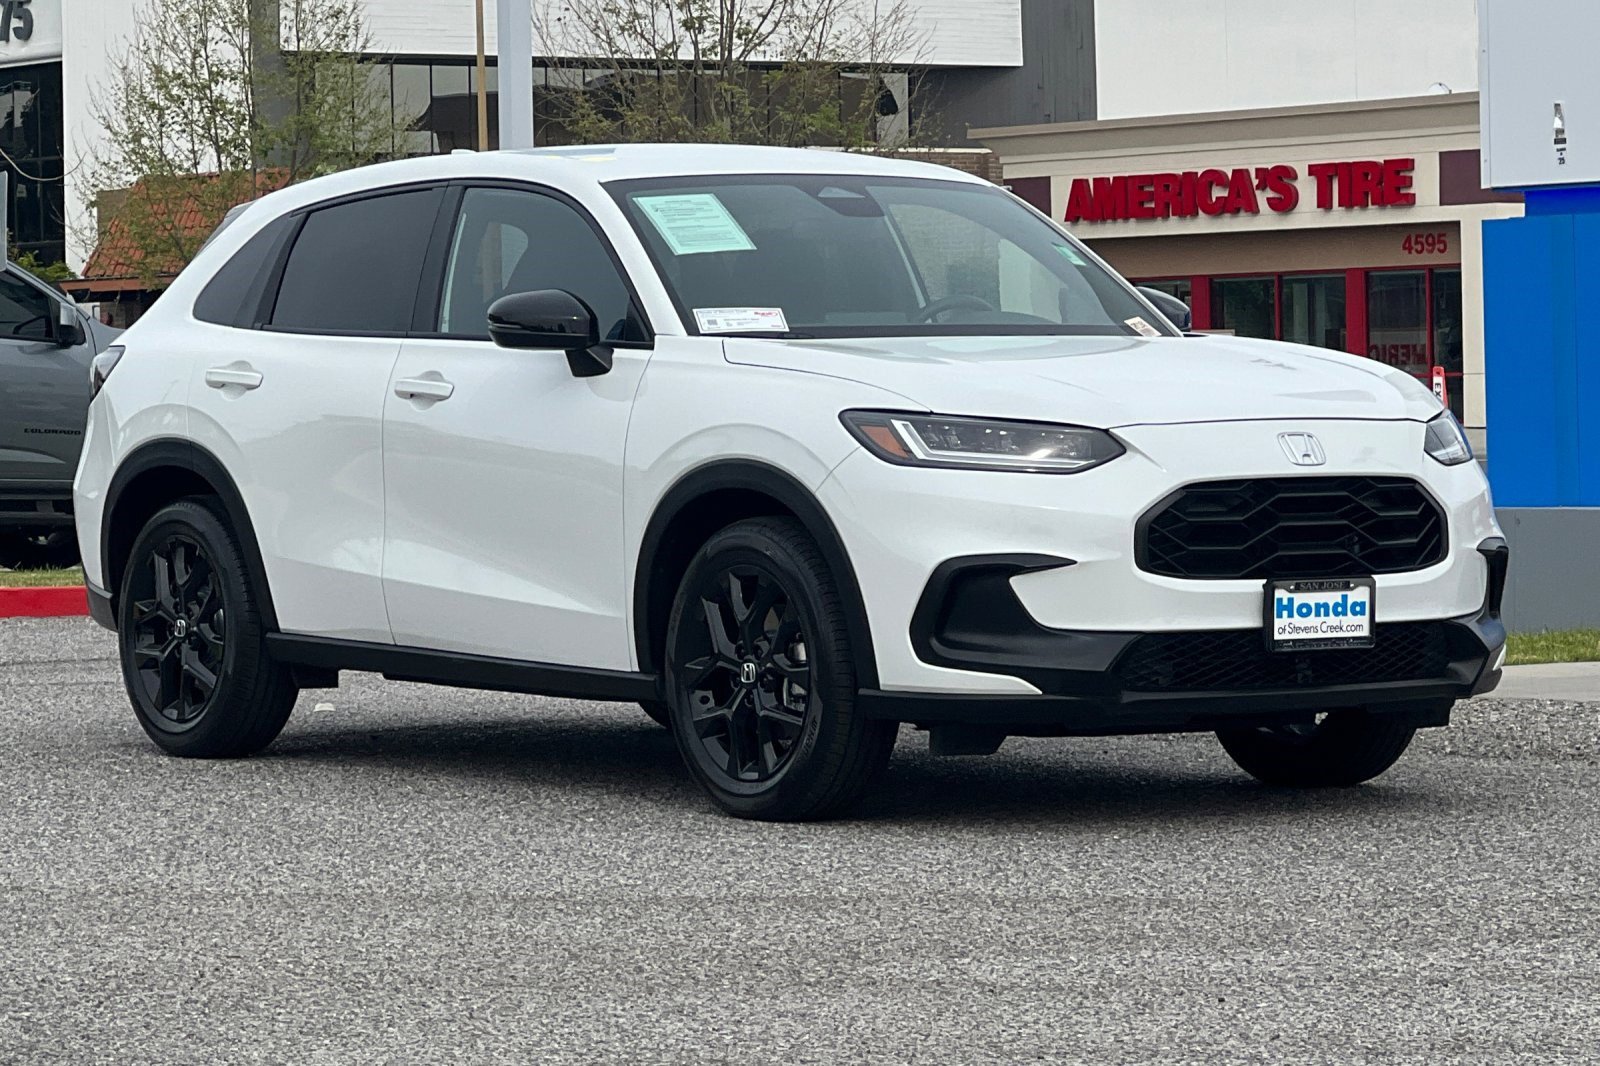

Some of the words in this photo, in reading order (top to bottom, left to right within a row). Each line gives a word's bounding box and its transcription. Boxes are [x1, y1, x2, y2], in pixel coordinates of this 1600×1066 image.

[1064, 165, 1299, 223] AMERICA'S
[1308, 158, 1416, 209] TIRE
[1401, 233, 1447, 254] 4595
[1321, 581, 1346, 589] JOSE
[1276, 594, 1366, 619] Honda
[1277, 625, 1287, 635] of
